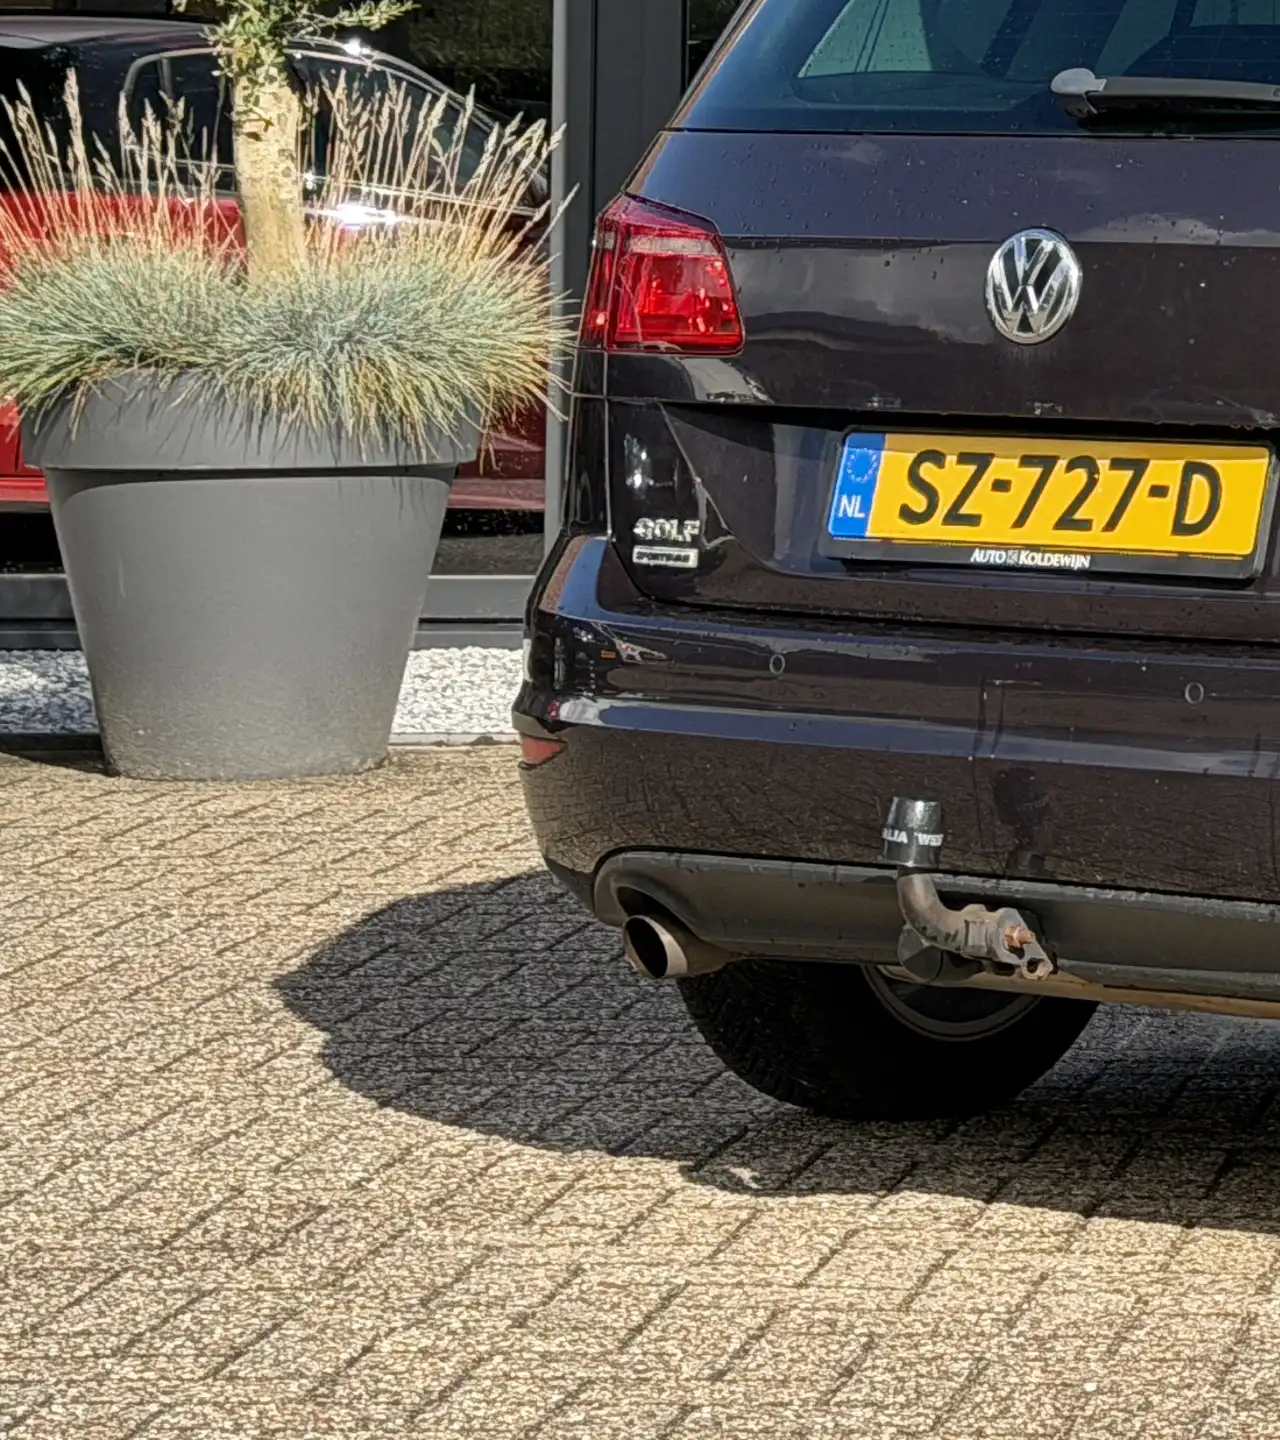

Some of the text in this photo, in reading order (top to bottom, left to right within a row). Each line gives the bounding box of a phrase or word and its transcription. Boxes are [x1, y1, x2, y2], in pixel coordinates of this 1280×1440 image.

[899, 448, 1223, 537] SZ-727-D
[838, 493, 866, 519] NL
[970, 548, 1091, 570] AUTO KOLDEWIJN
